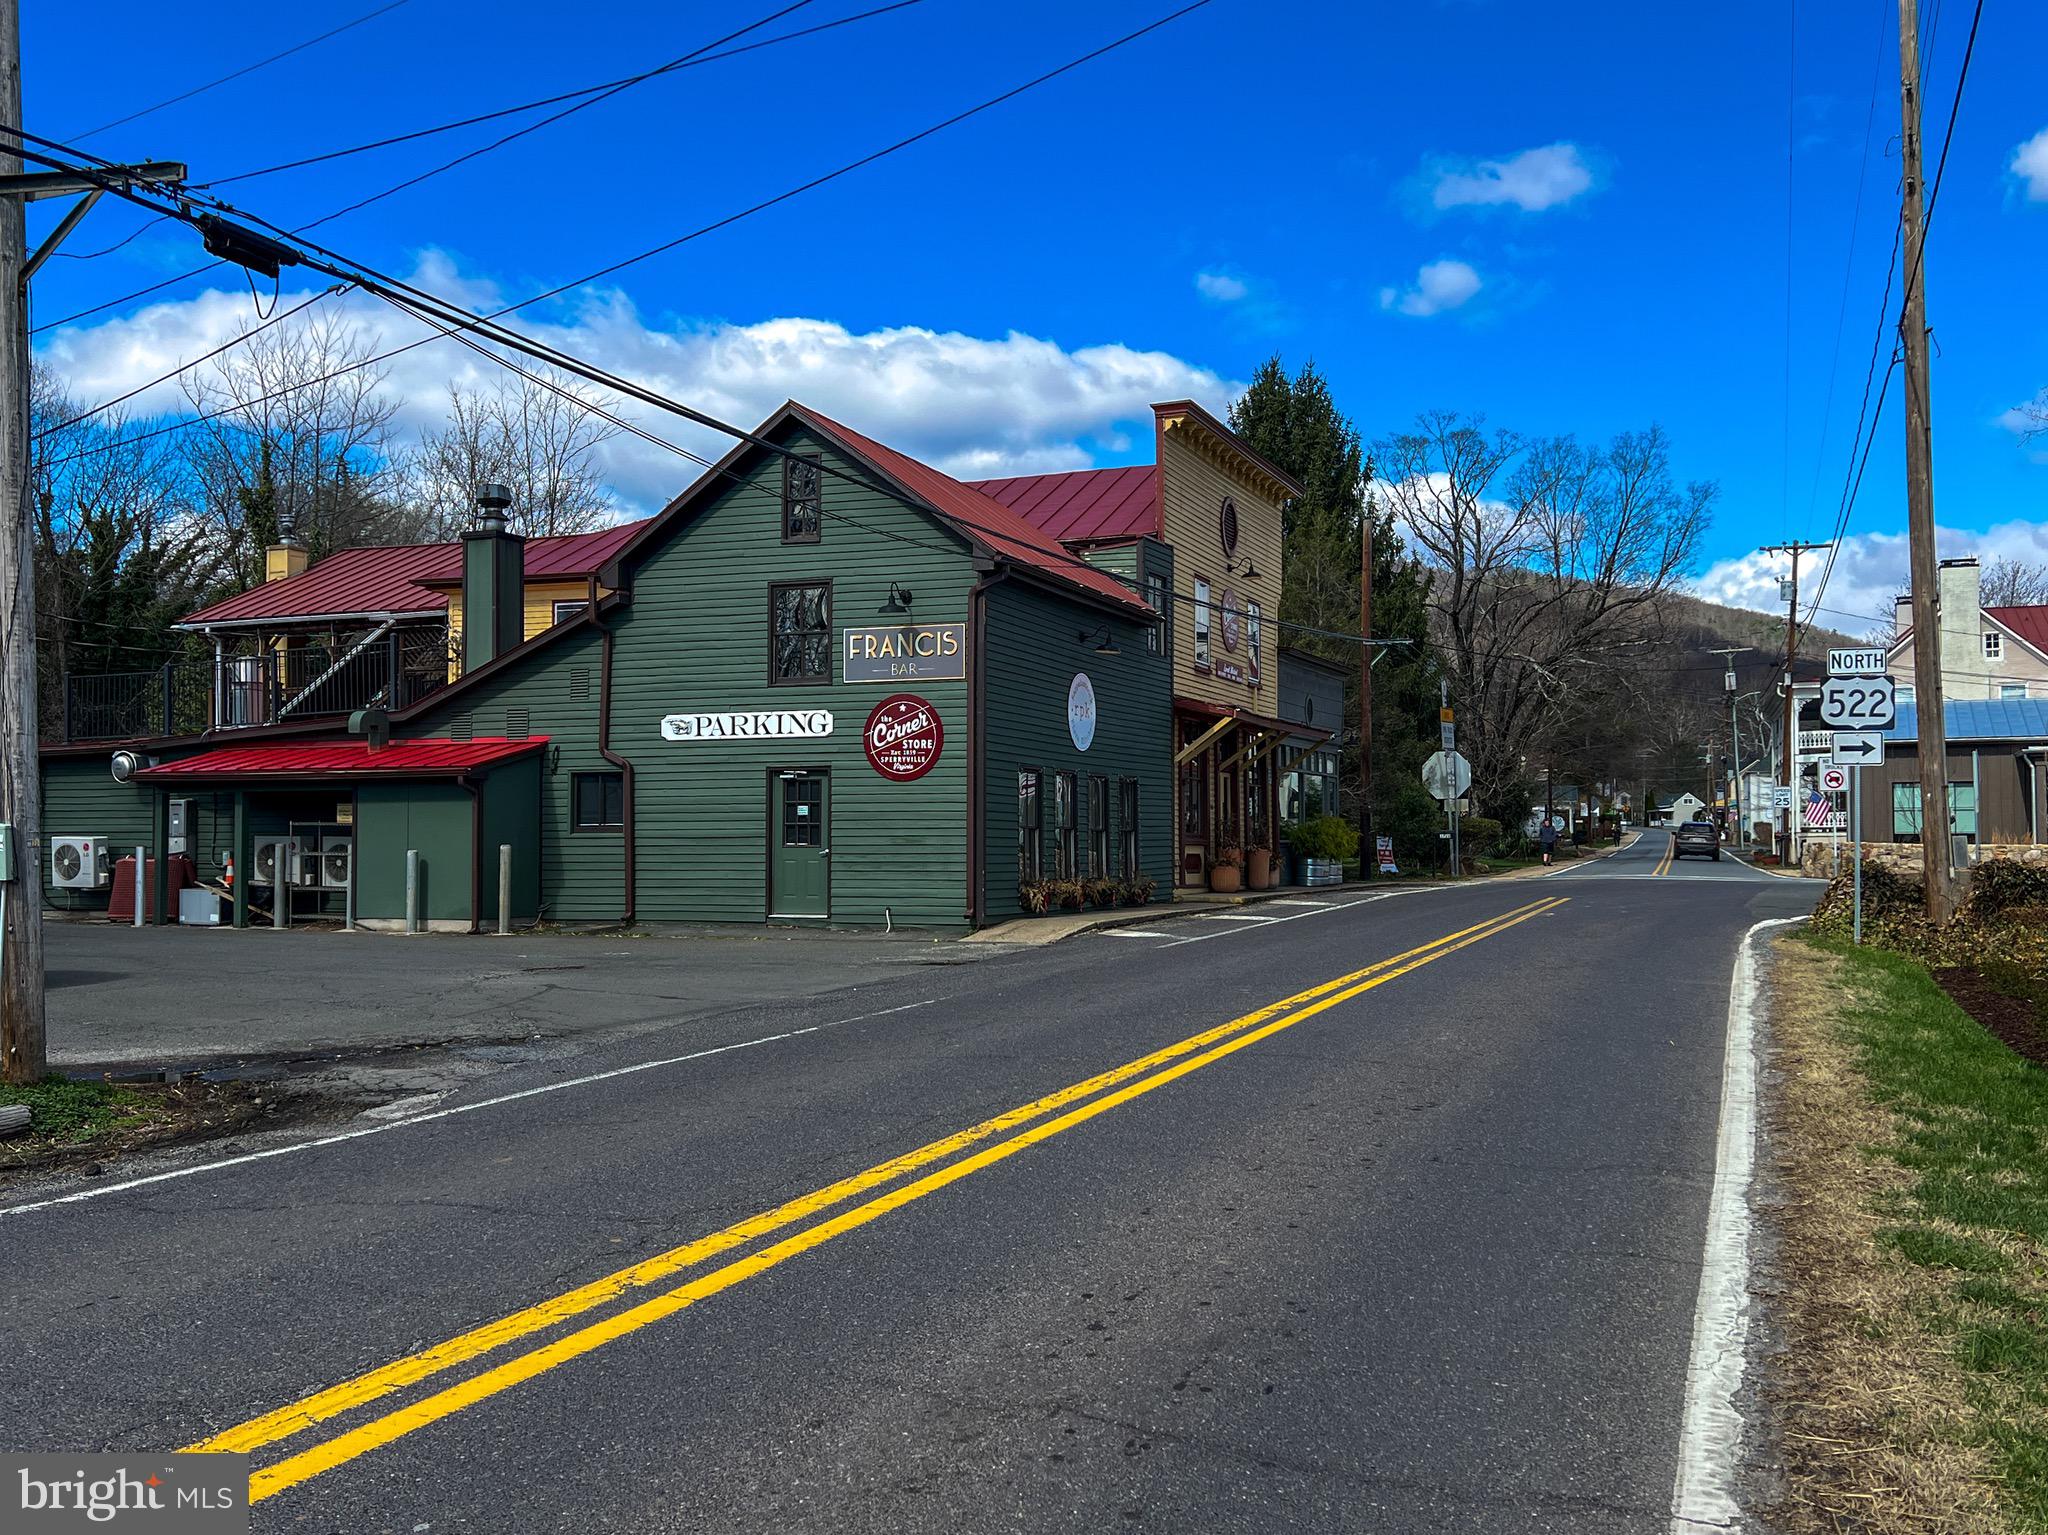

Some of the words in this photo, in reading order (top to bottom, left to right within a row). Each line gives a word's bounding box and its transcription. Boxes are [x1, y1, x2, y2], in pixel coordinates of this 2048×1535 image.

[849, 630, 959, 660] FRANCIS
[891, 662, 918, 676] BAR
[1831, 653, 1884, 669] NORTH
[1828, 688, 1887, 718] 522
[694, 712, 829, 737] PARKING
[880, 714, 893, 722] the
[873, 712, 929, 747] Corner
[902, 739, 933, 749] STORE
[1775, 797, 1790, 806] 25
